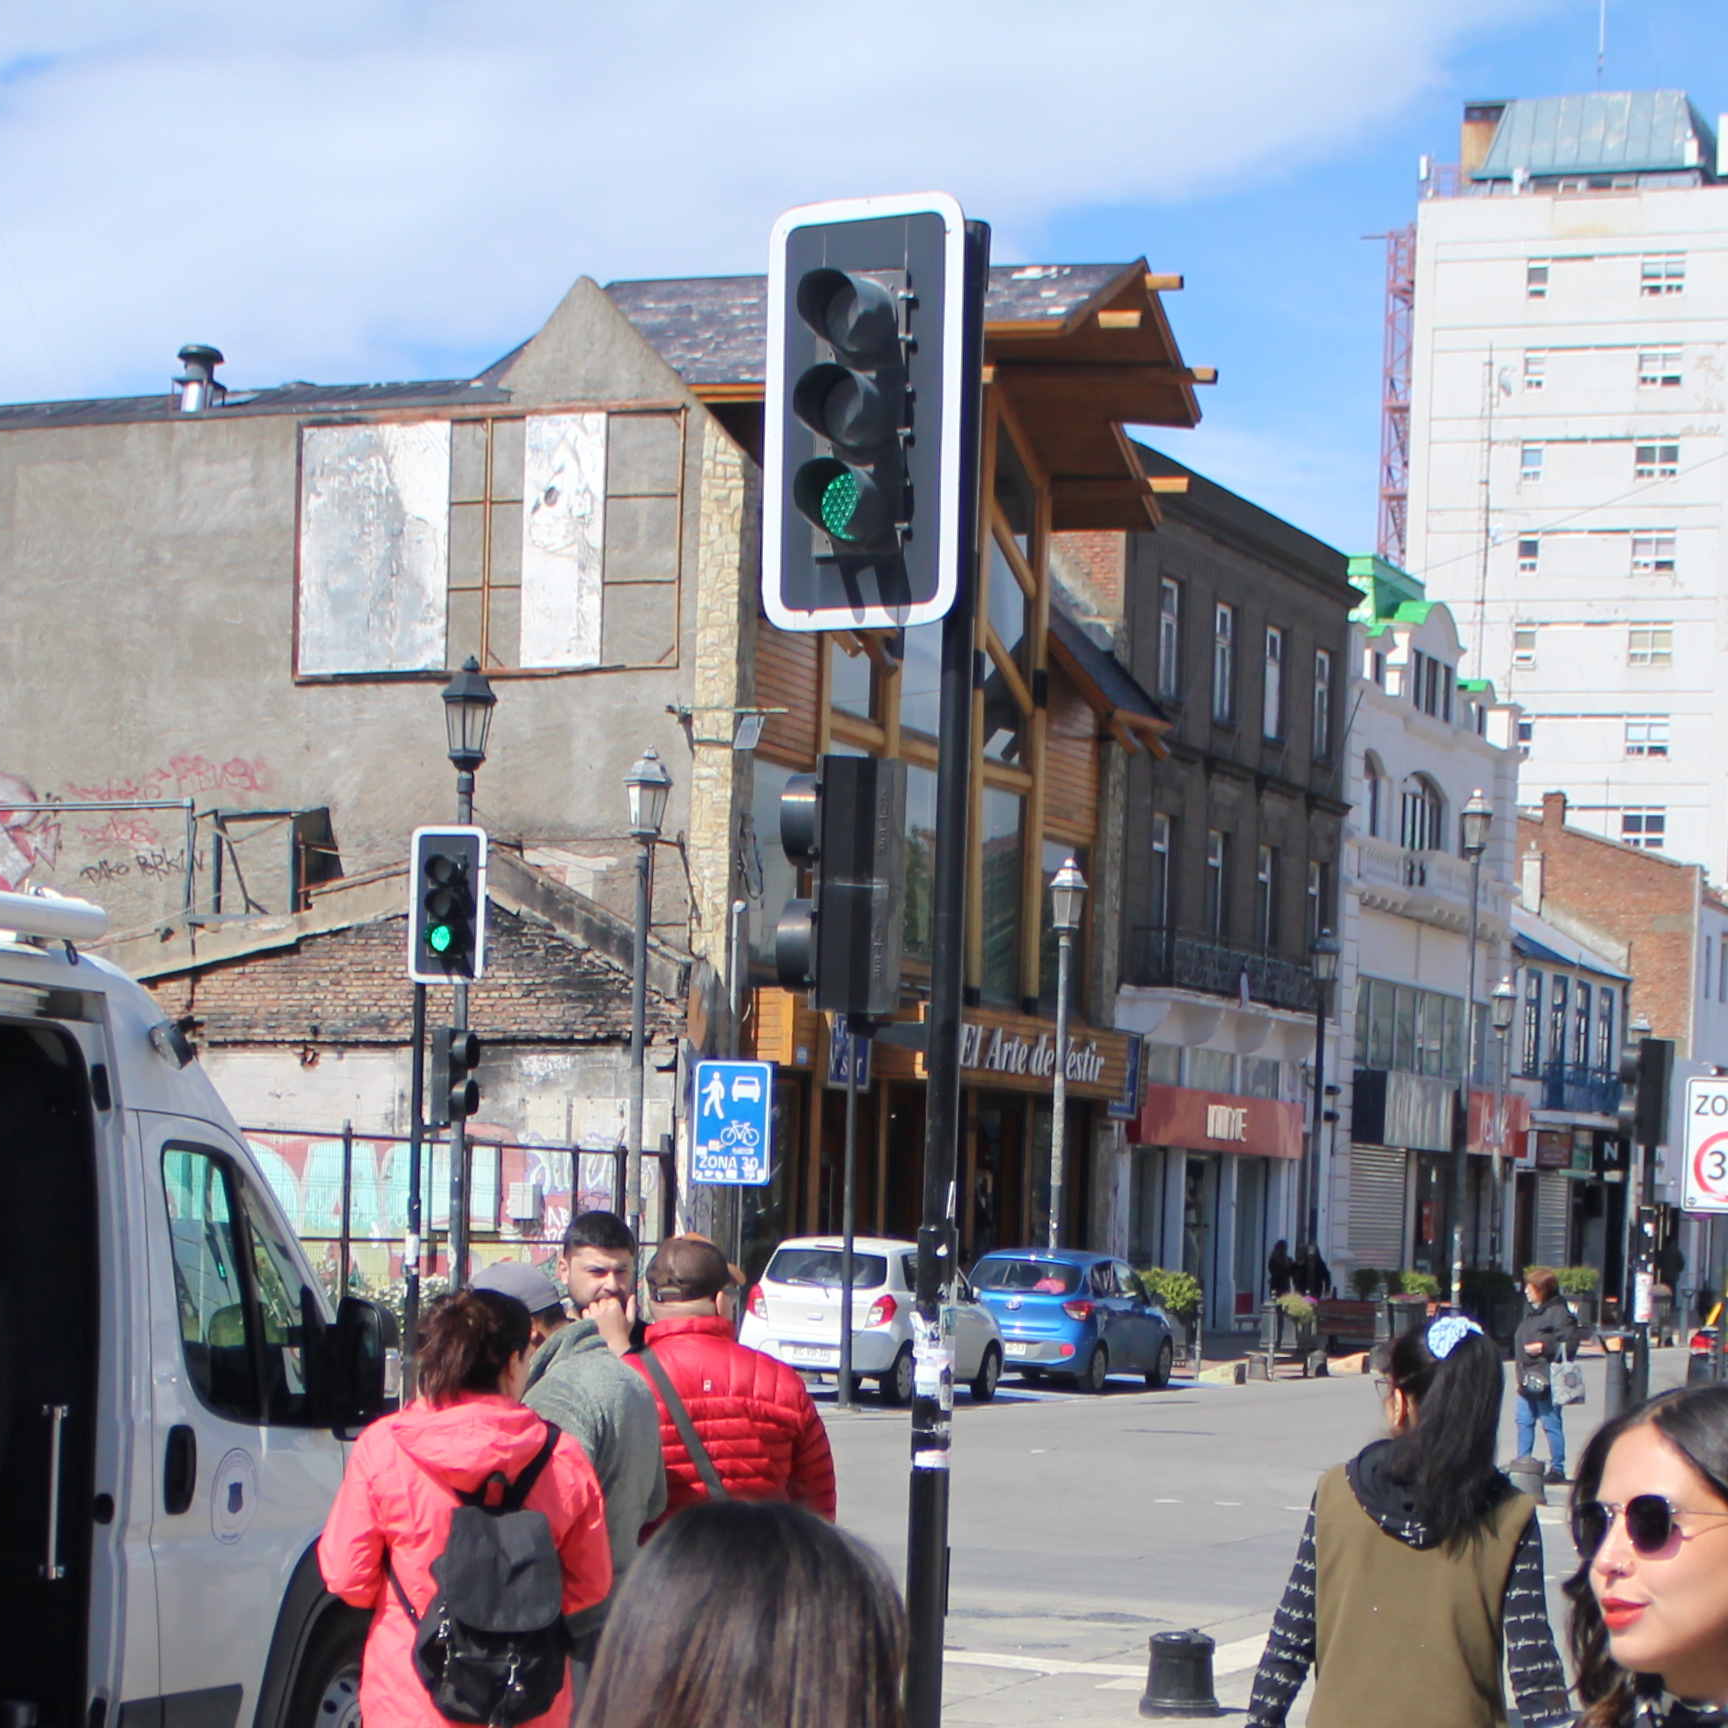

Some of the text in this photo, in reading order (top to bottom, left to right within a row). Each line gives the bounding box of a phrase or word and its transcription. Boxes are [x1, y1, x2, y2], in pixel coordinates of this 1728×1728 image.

[960, 1023, 984, 1069] El
[985, 1027, 1028, 1077] Arte
[1029, 1033, 1052, 1078] de
[698, 1155, 759, 1171] ZONA 30
